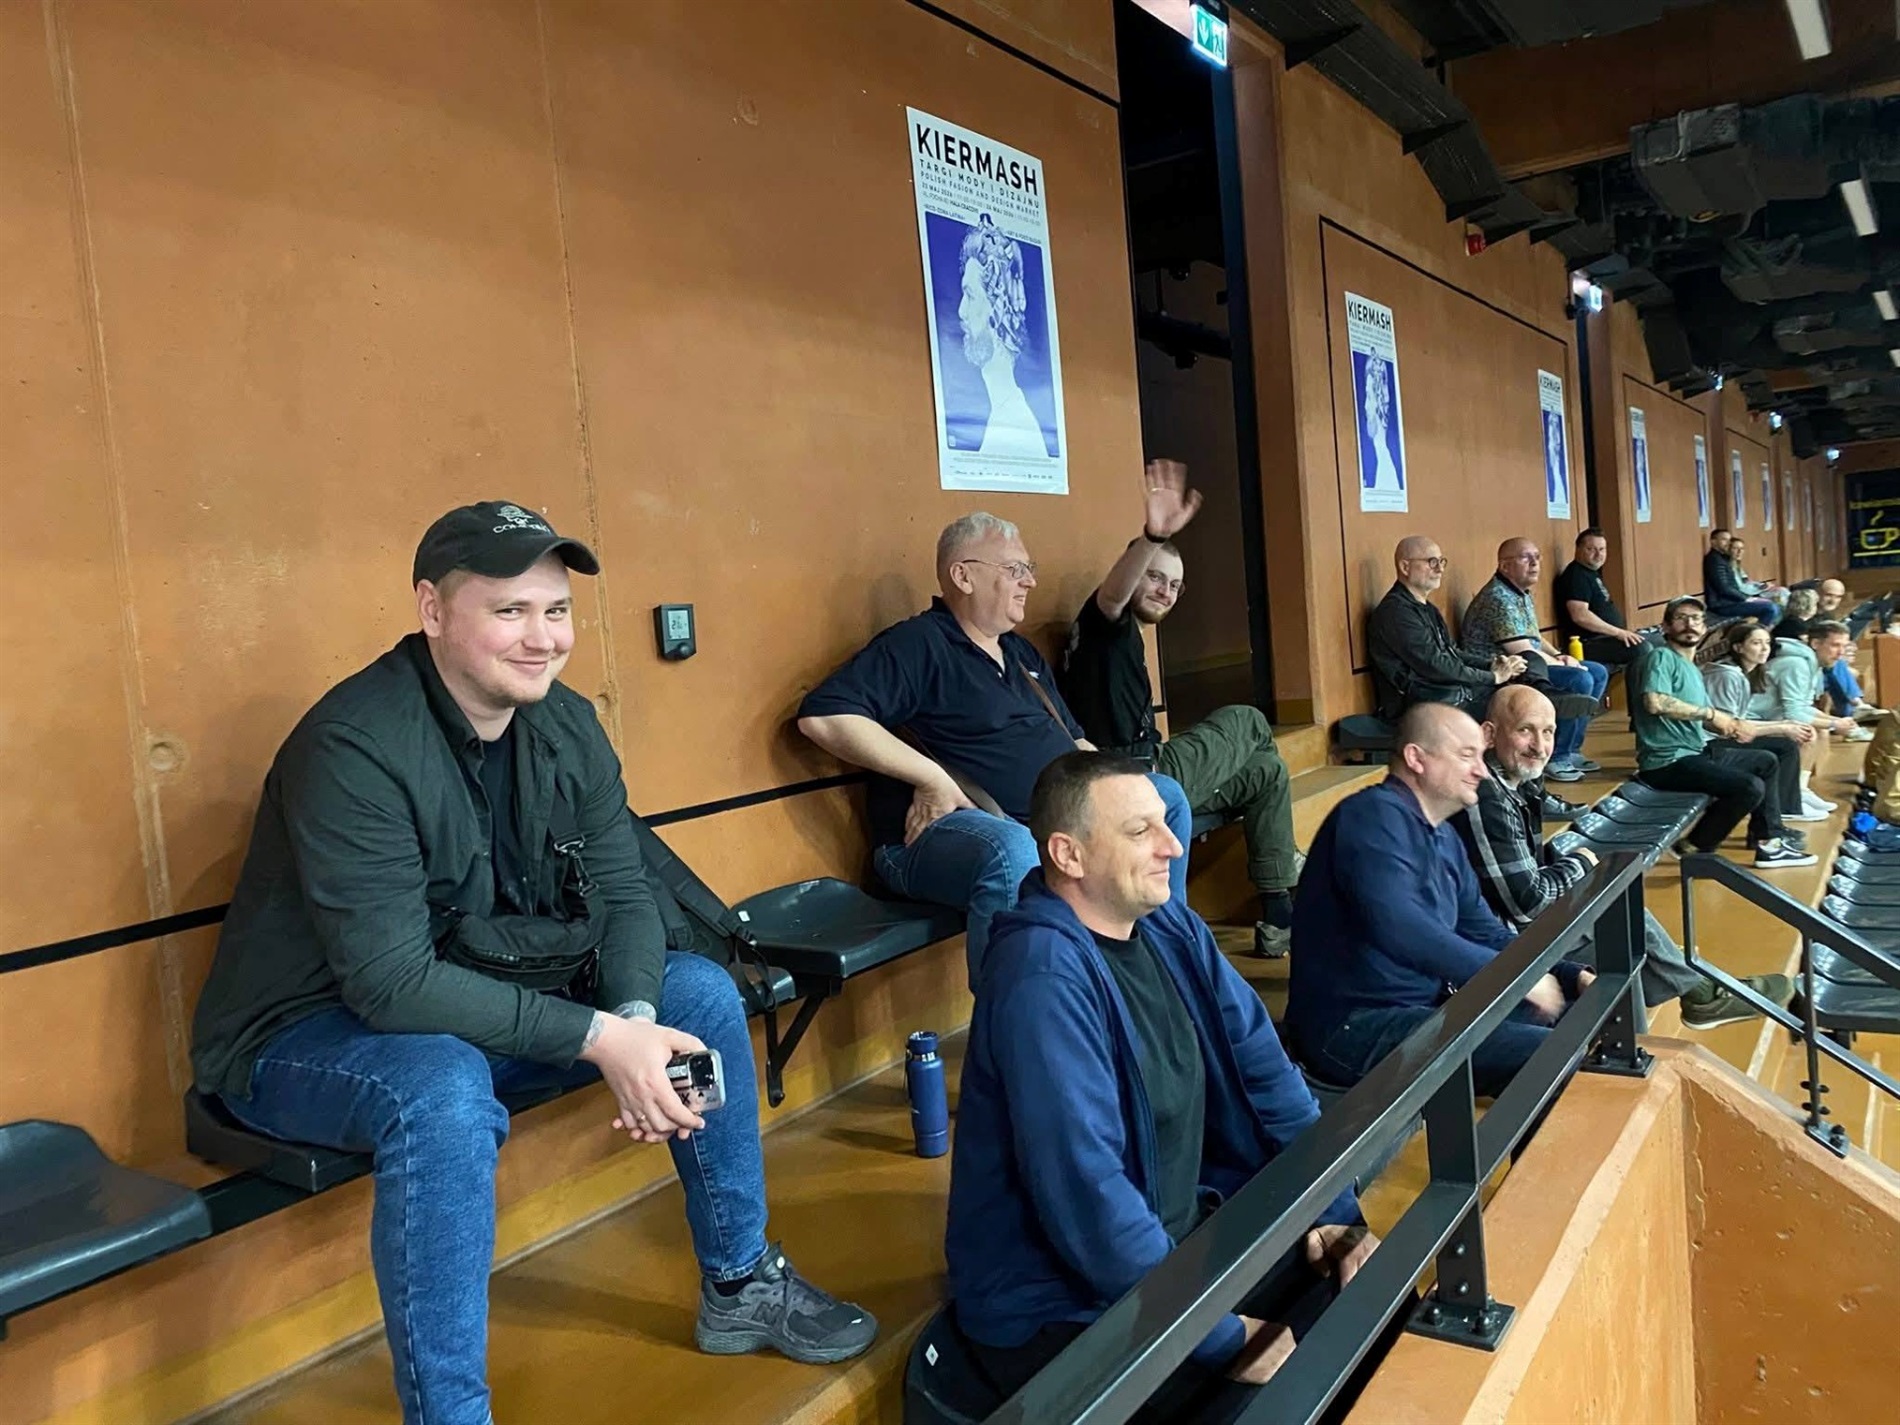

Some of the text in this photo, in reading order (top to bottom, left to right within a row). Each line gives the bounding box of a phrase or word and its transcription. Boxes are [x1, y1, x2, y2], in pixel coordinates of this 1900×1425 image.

[916, 123, 1038, 196] KIERMASH
[921, 170, 946, 184] POLISH
[920, 159, 952, 178] TARGI
[958, 173, 986, 190] MODY
[1000, 187, 1039, 208] DIZAJNU
[1348, 300, 1391, 332] KIERMASH
